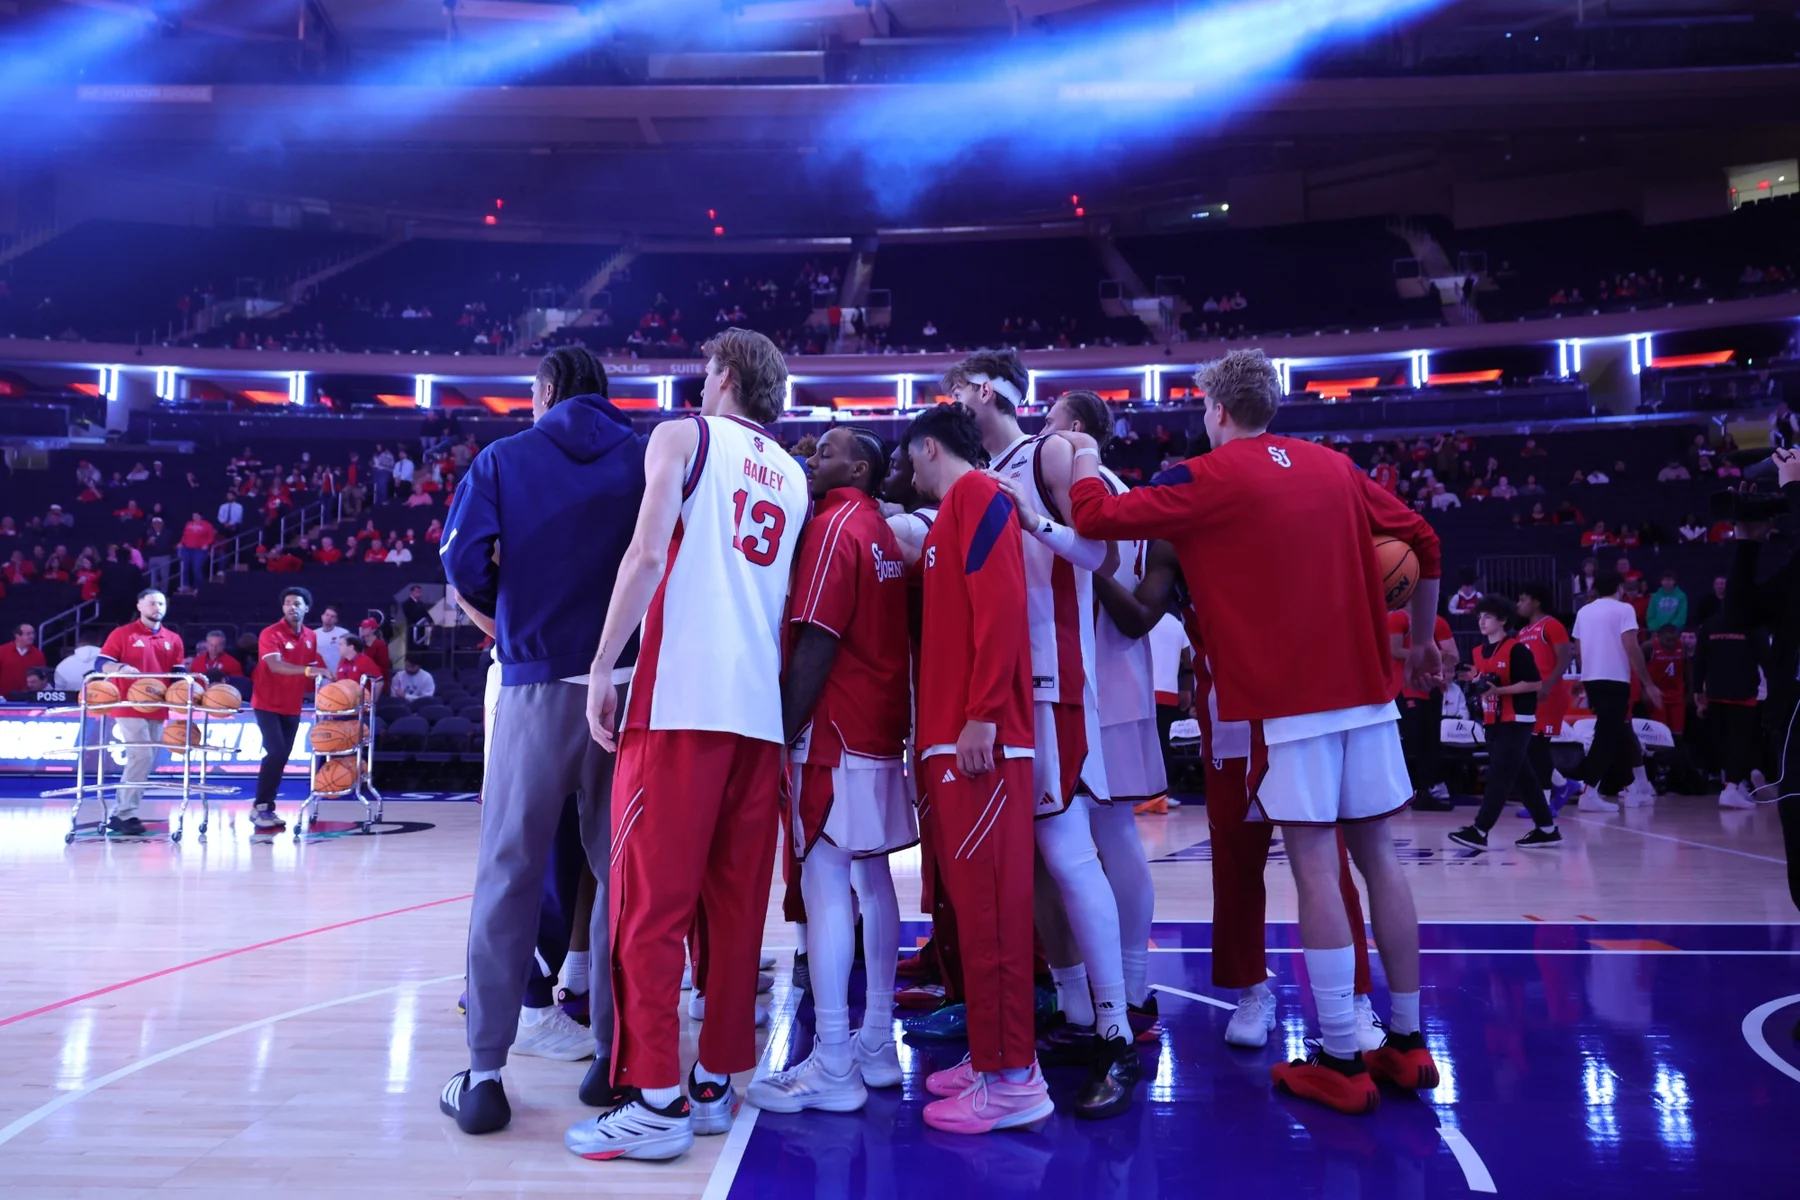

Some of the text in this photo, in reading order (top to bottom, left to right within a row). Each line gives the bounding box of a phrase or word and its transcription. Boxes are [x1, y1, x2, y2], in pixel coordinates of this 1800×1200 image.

[604, 364, 650, 373] EXUS
[743, 457, 784, 491] BAILEY
[733, 488, 786, 567] 13
[1665, 661, 1675, 676] 4
[37, 691, 66, 701] POSS
